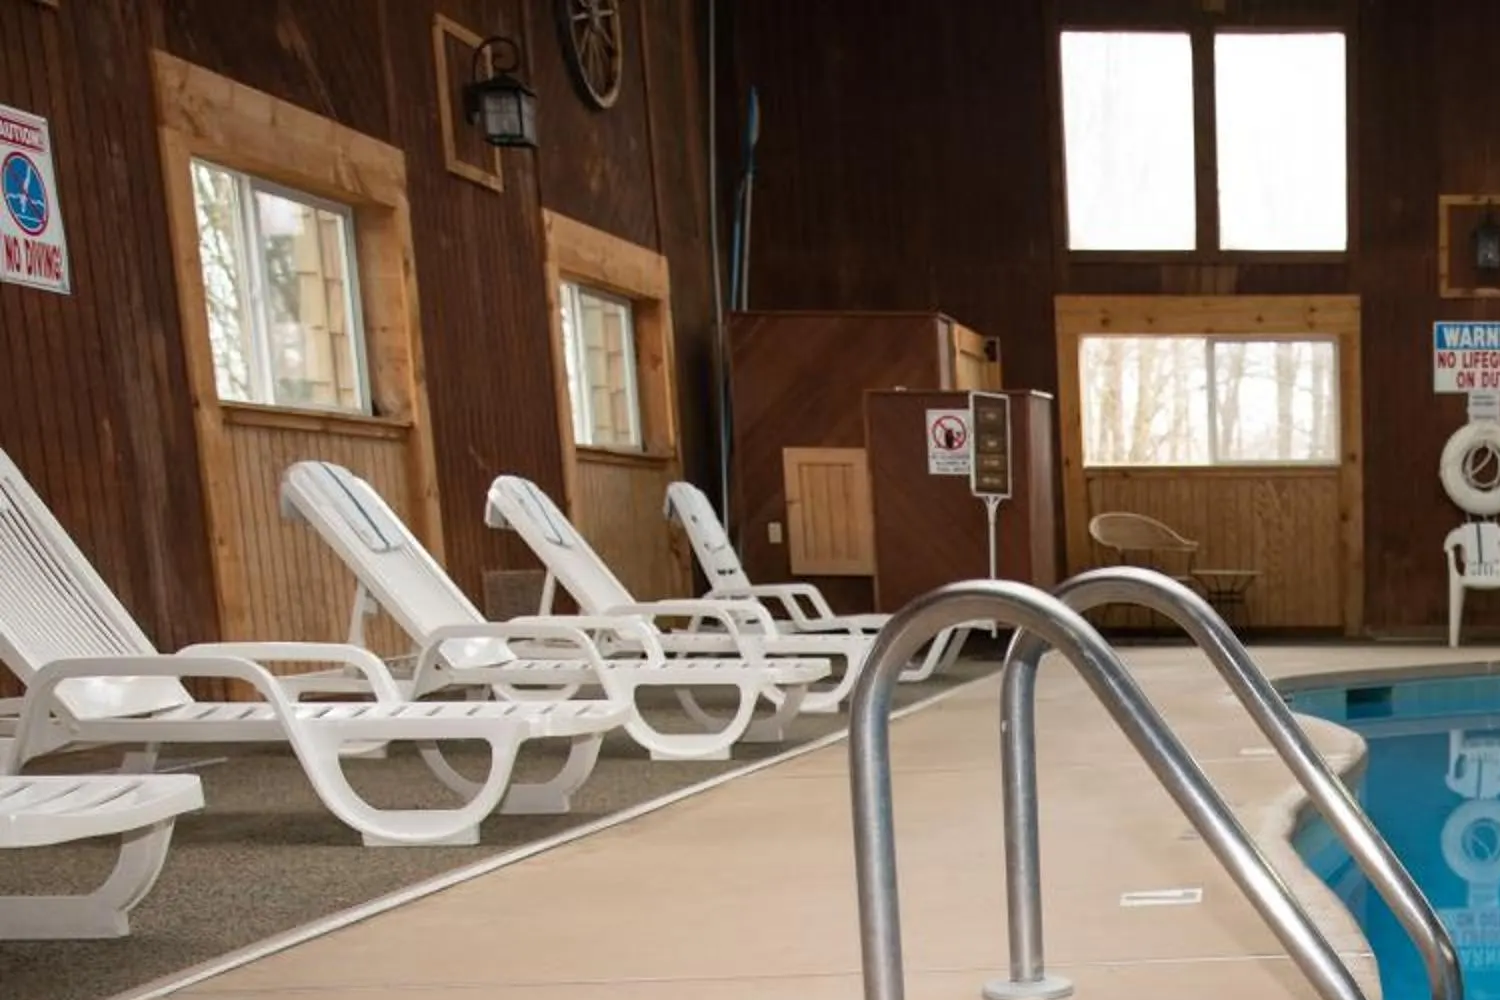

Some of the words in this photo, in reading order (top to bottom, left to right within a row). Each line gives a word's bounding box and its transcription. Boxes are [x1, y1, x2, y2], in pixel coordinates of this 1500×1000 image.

[4, 234, 20, 273] NO
[1437, 352, 1456, 369] NO
[1456, 372, 1475, 389] ON
